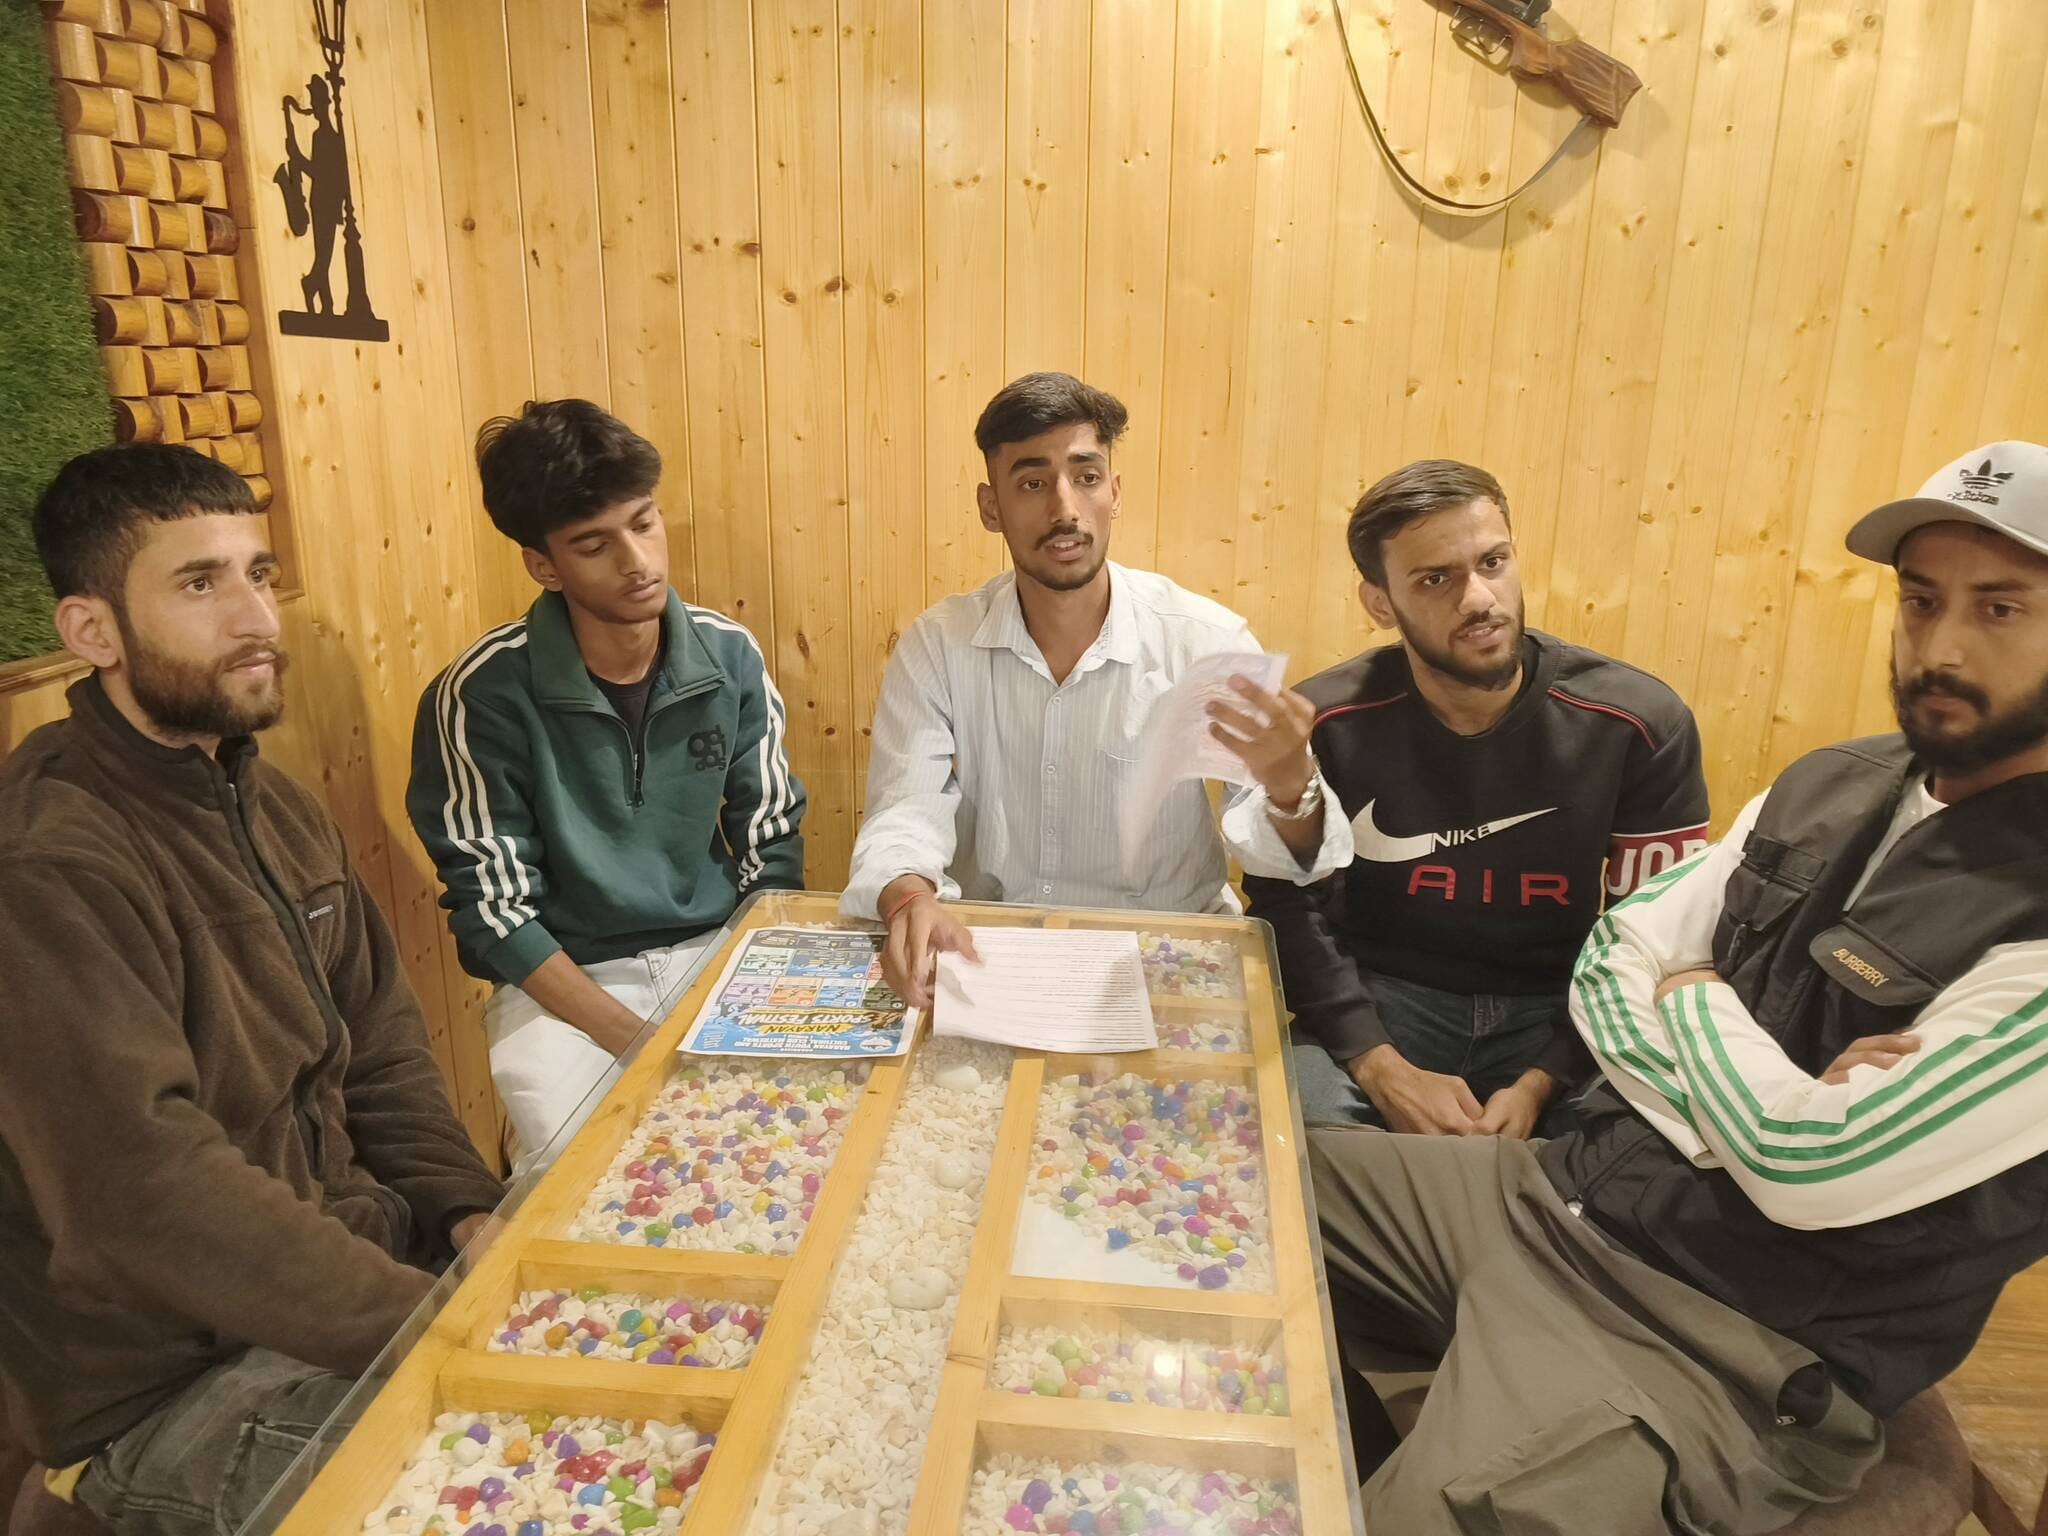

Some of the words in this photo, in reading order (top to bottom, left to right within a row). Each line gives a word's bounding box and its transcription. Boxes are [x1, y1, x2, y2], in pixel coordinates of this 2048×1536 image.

[1431, 823, 1491, 853] NIKE
[1407, 865, 1570, 906] AIR
[1832, 948, 1890, 988] BURBERRY
[738, 1013, 809, 1025] FESTIVAL
[764, 1024, 840, 1033] NARAYAN
[811, 1013, 873, 1024] SPORTS
